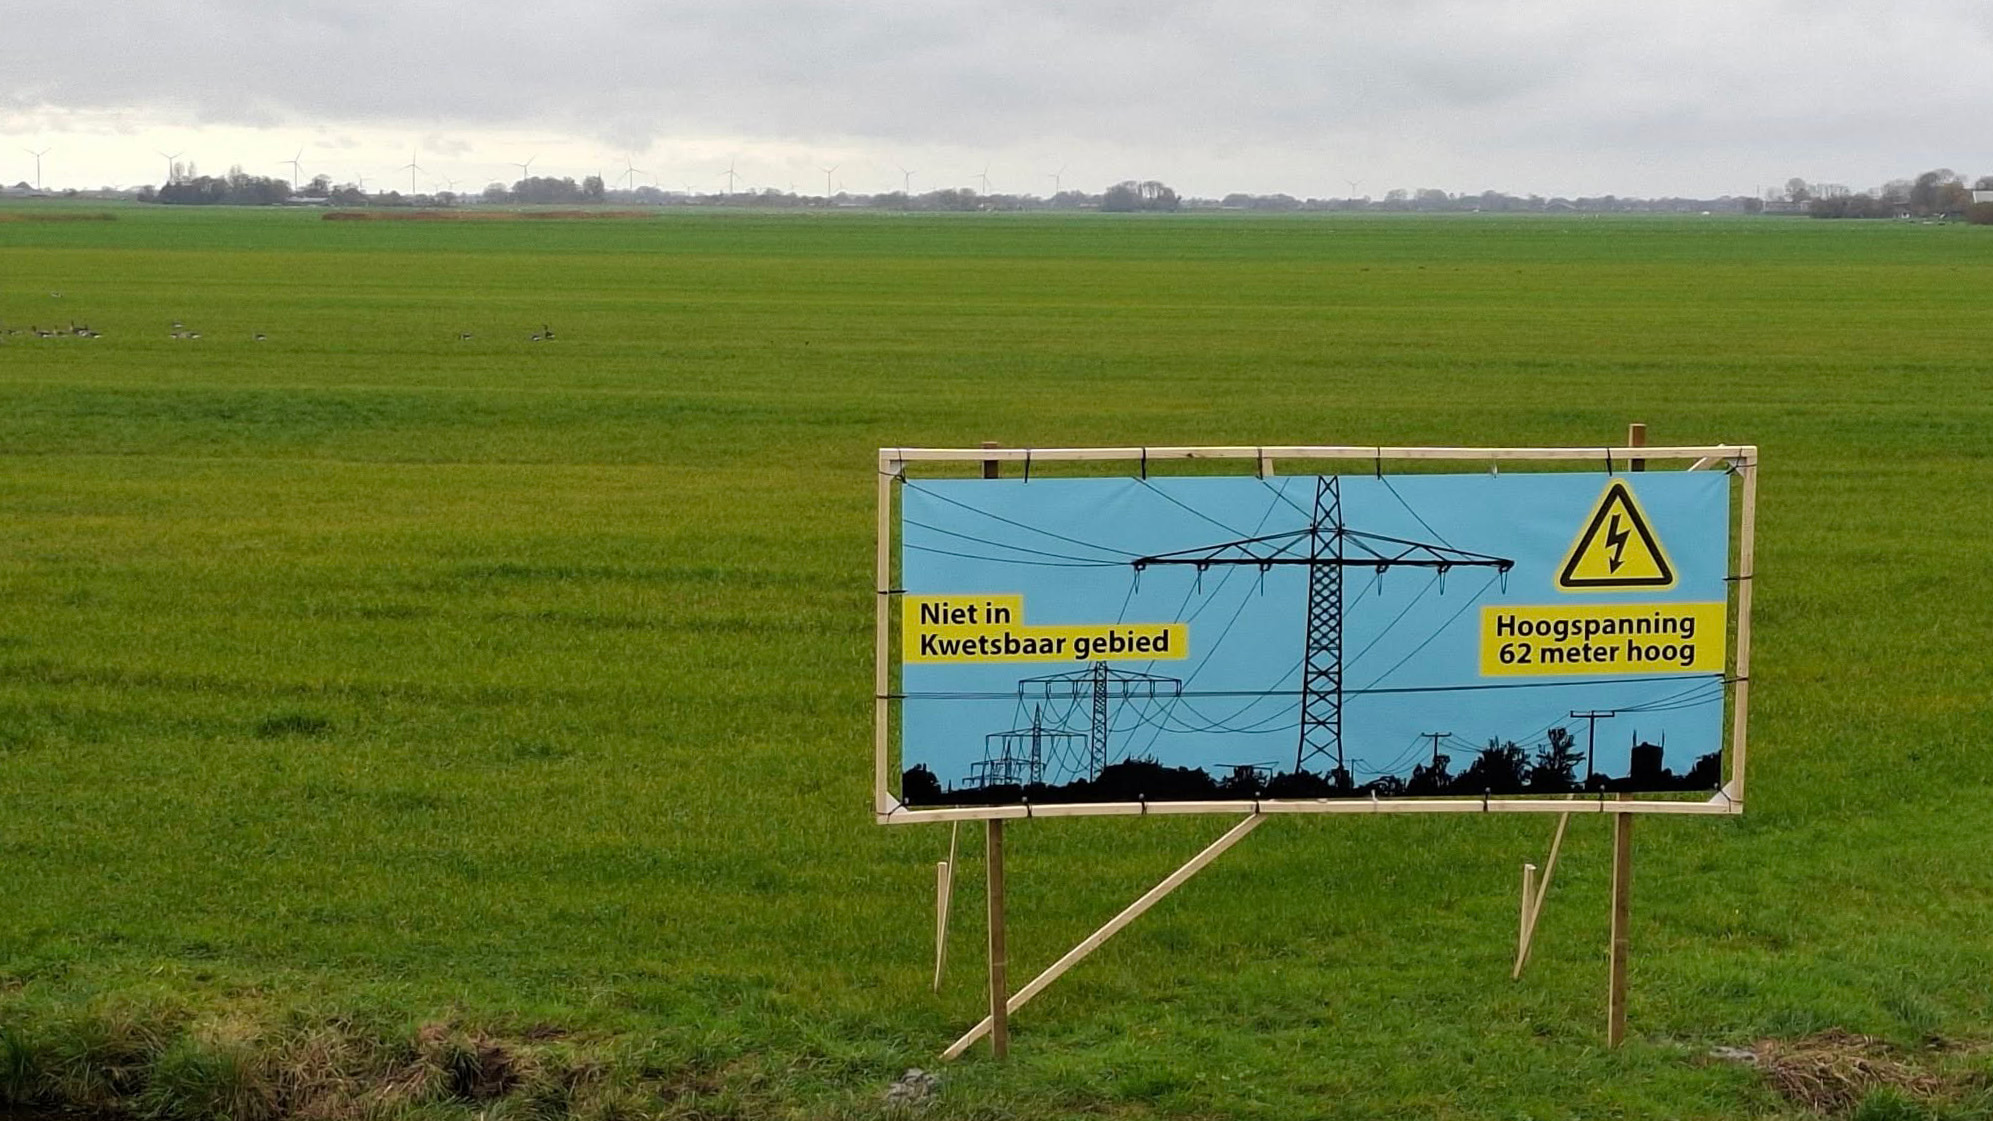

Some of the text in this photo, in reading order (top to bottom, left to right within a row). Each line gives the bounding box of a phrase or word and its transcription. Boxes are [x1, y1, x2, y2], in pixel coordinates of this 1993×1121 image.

[920, 601, 1011, 625] Niet in
[1496, 612, 1696, 642] Hoogspanning
[920, 629, 1169, 660] Kwetsbaar gebied
[1499, 639, 1696, 666] 62 meter hoog
